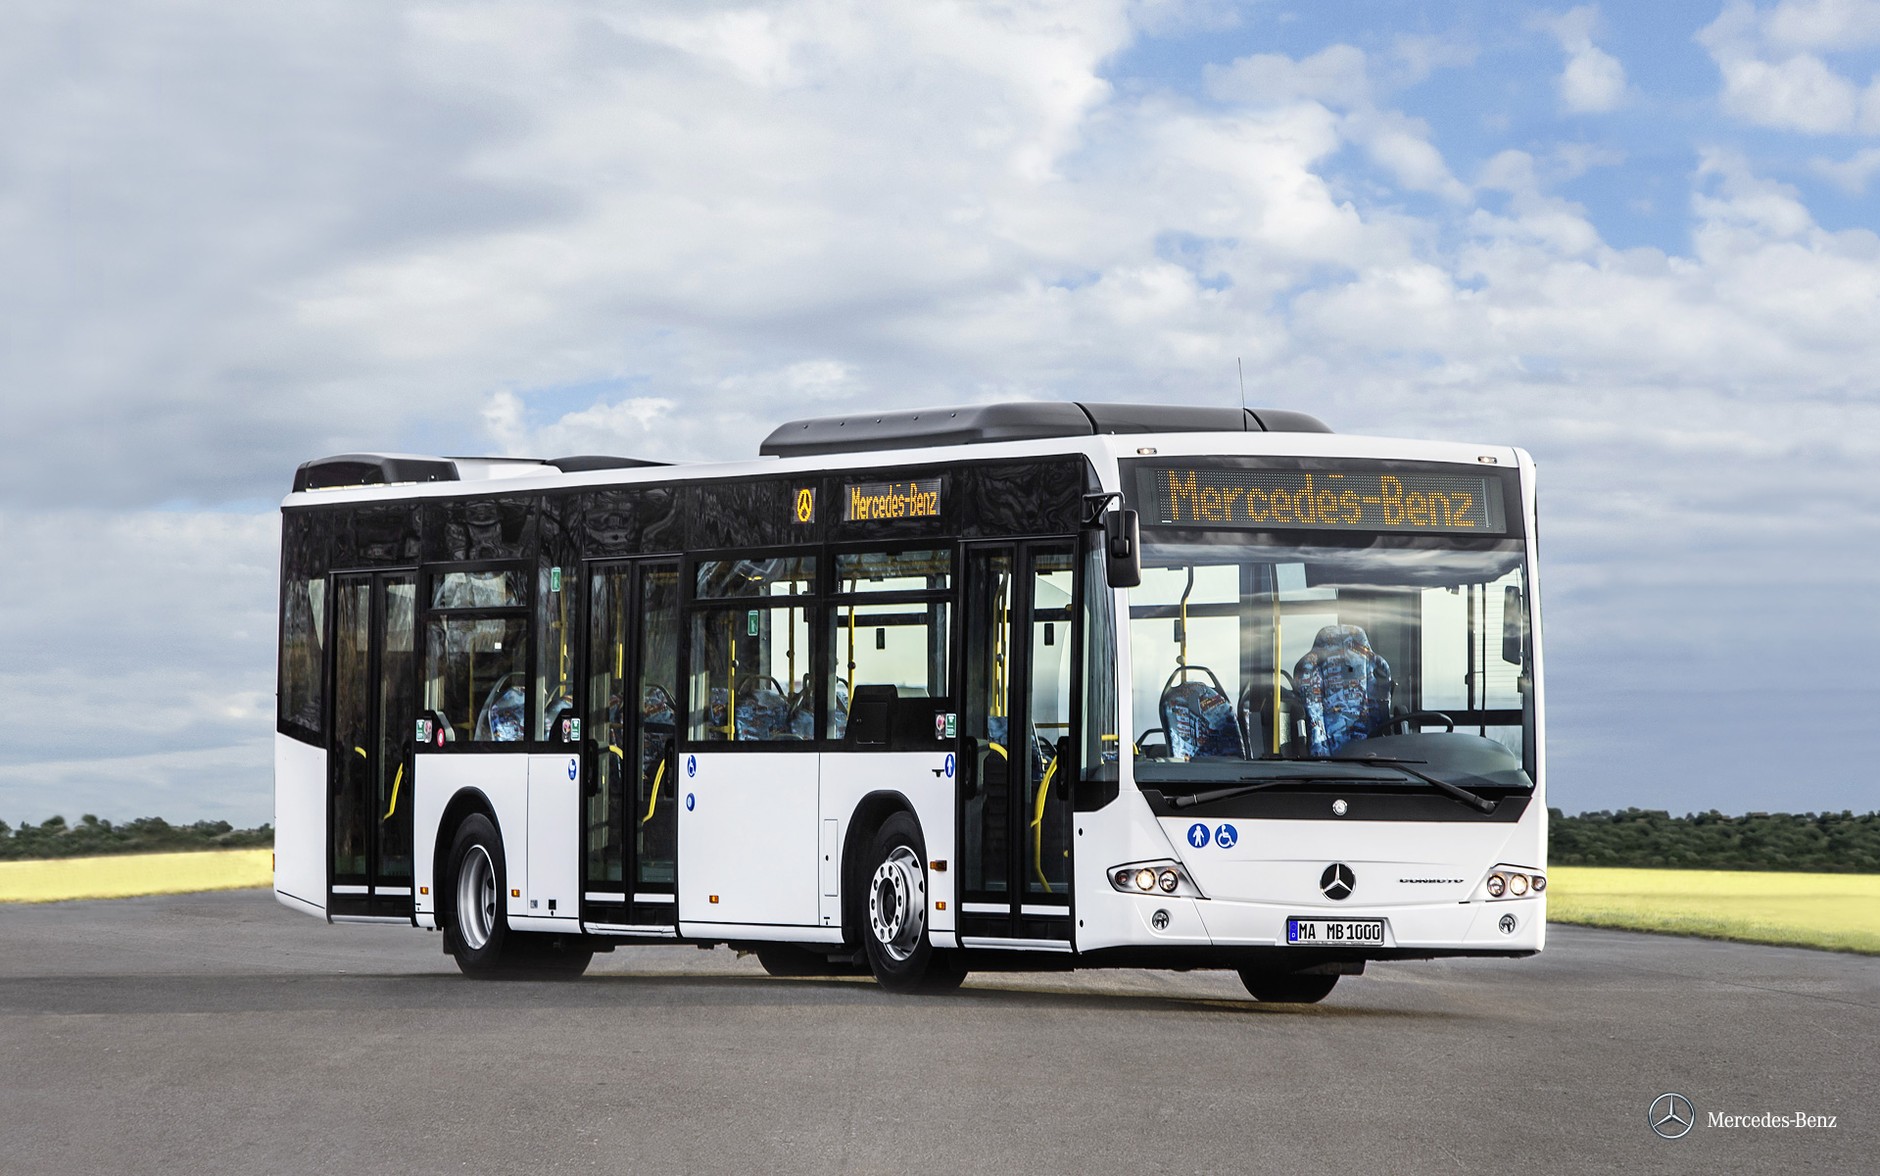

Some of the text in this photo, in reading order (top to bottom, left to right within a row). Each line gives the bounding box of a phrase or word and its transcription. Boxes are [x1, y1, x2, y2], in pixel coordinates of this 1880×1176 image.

[851, 483, 936, 520] Mercedes-Benz
[1167, 469, 1475, 527] Mercedes-Benz
[1299, 923, 1316, 940] MA
[1346, 924, 1380, 940] 1000
